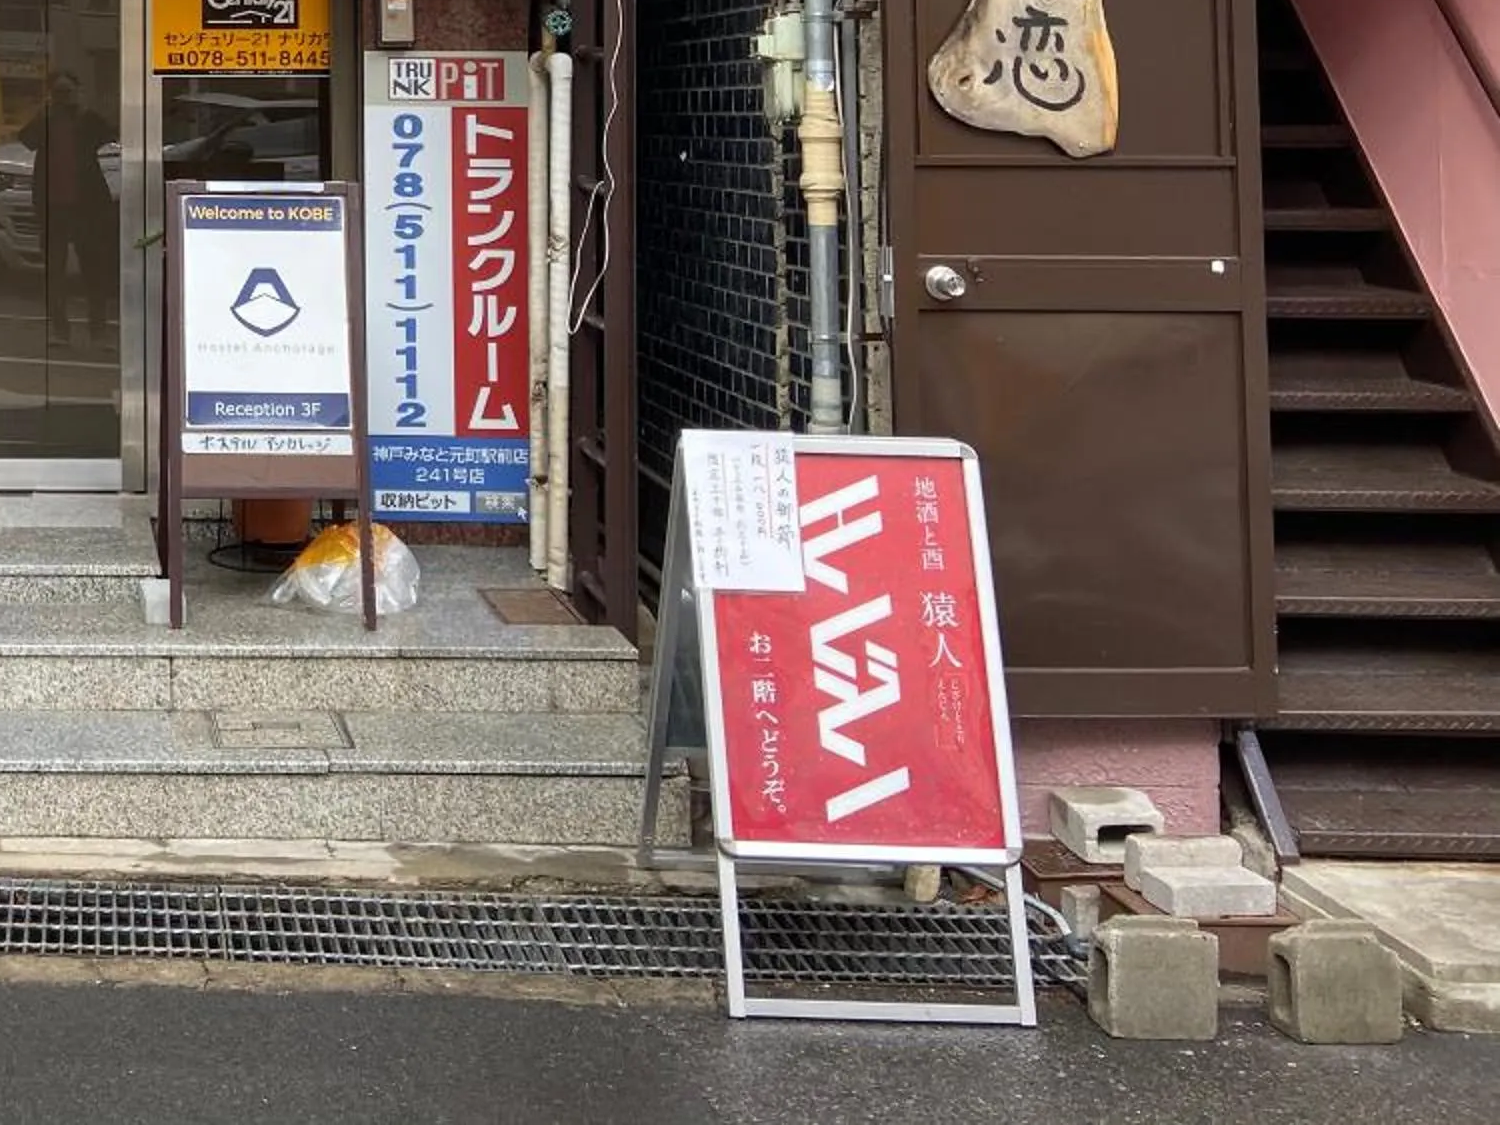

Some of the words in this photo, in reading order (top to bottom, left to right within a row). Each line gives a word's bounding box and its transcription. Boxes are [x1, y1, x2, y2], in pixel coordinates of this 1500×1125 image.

[273, 0, 295, 24] 21
[164, 32, 270, 46] センチュリー21
[188, 205, 264, 220] Welcome
[267, 207, 284, 220] to
[287, 207, 333, 221] KOBE
[385, 113, 434, 428] 078(511)1112
[465, 114, 520, 430] トランクルーム
[198, 343, 247, 354] Hostel
[253, 343, 335, 357] Anchorage
[215, 402, 295, 418] Reception
[300, 402, 321, 416] 3F
[415, 467, 486, 485] 241号店
[920, 591, 963, 669] 猿人
